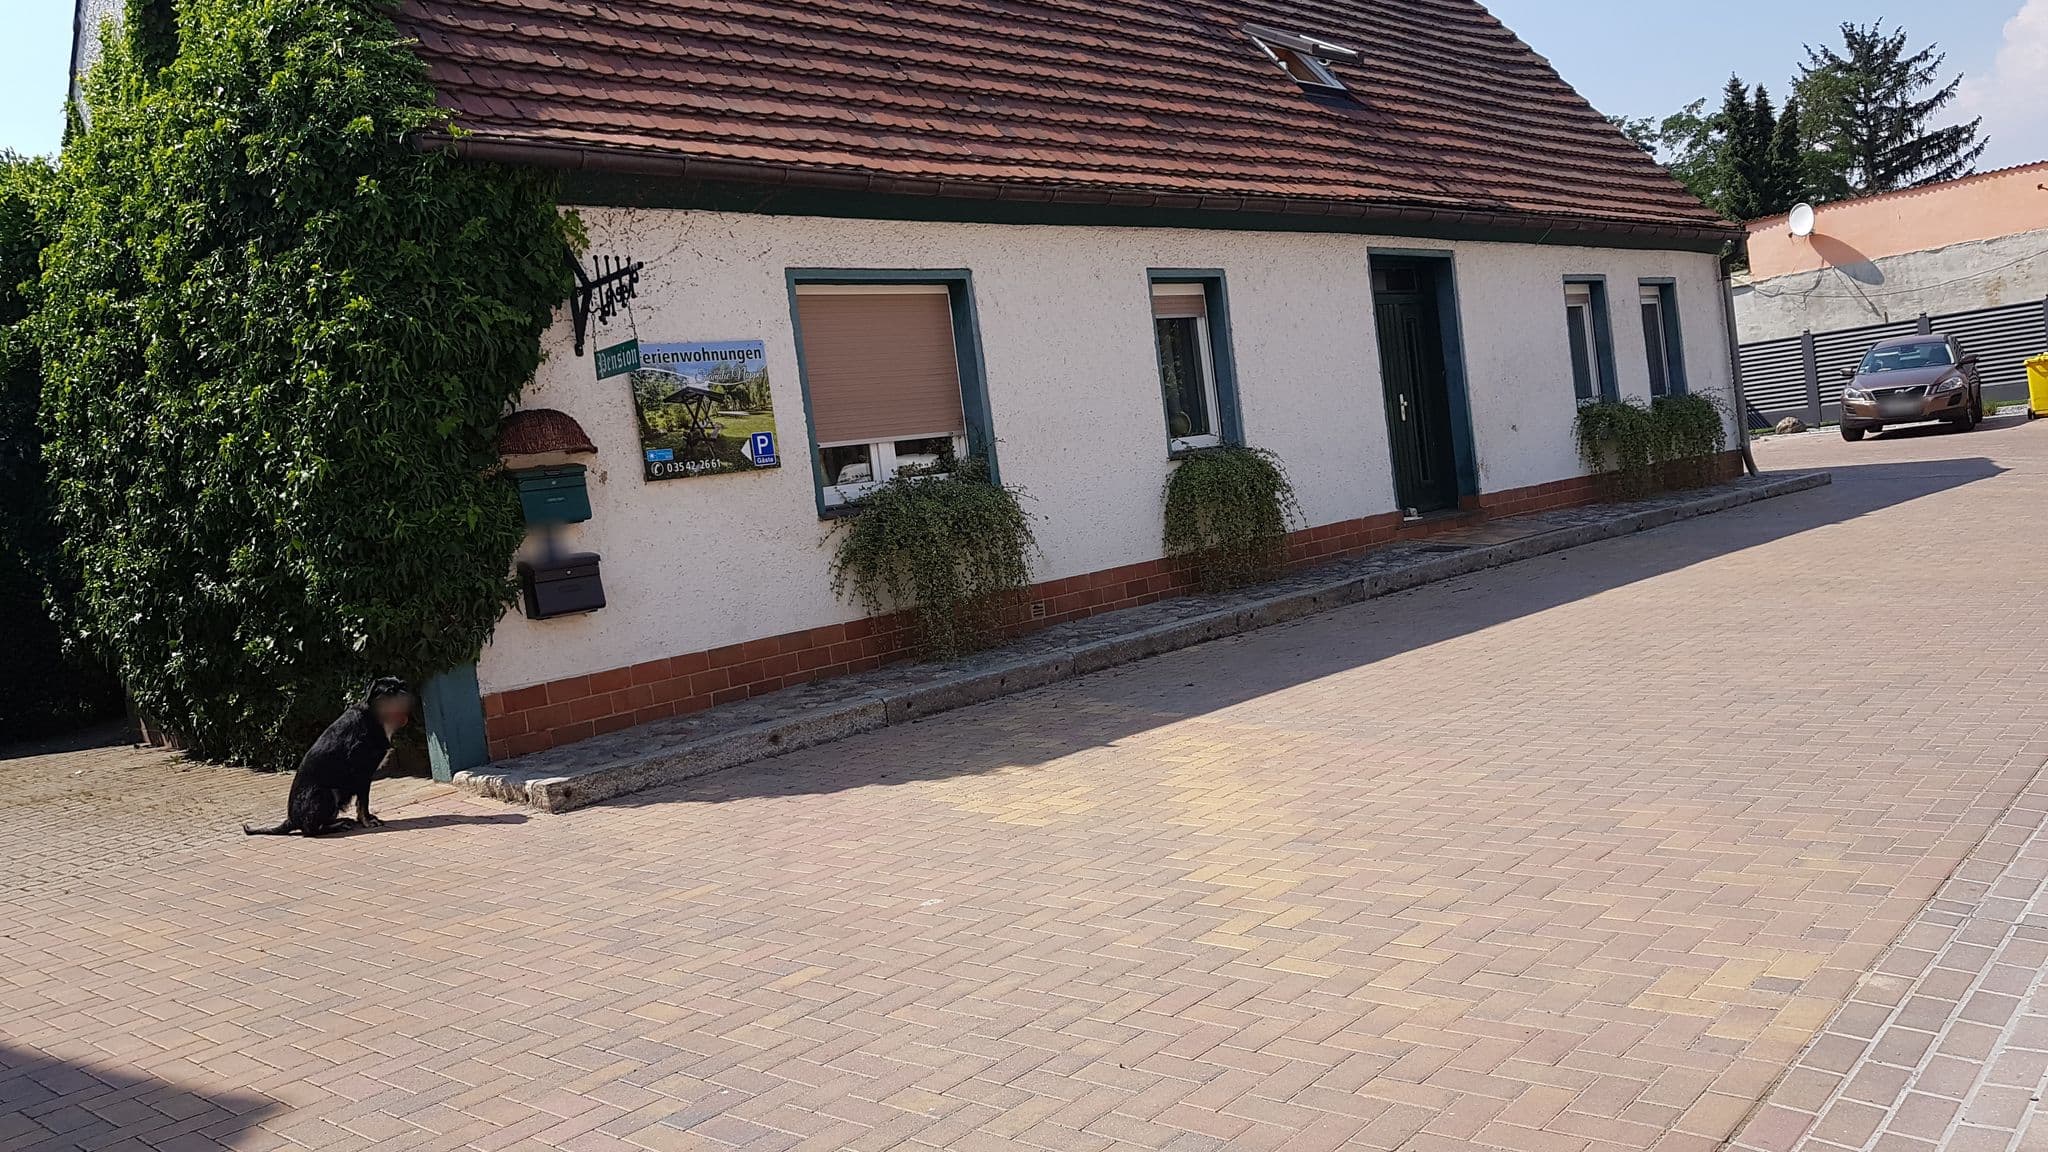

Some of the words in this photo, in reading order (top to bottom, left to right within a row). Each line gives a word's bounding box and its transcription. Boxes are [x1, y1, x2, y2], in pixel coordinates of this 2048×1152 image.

[597, 345, 638, 377] Pension
[640, 347, 762, 364] erienwohnungen
[756, 435, 769, 455] P
